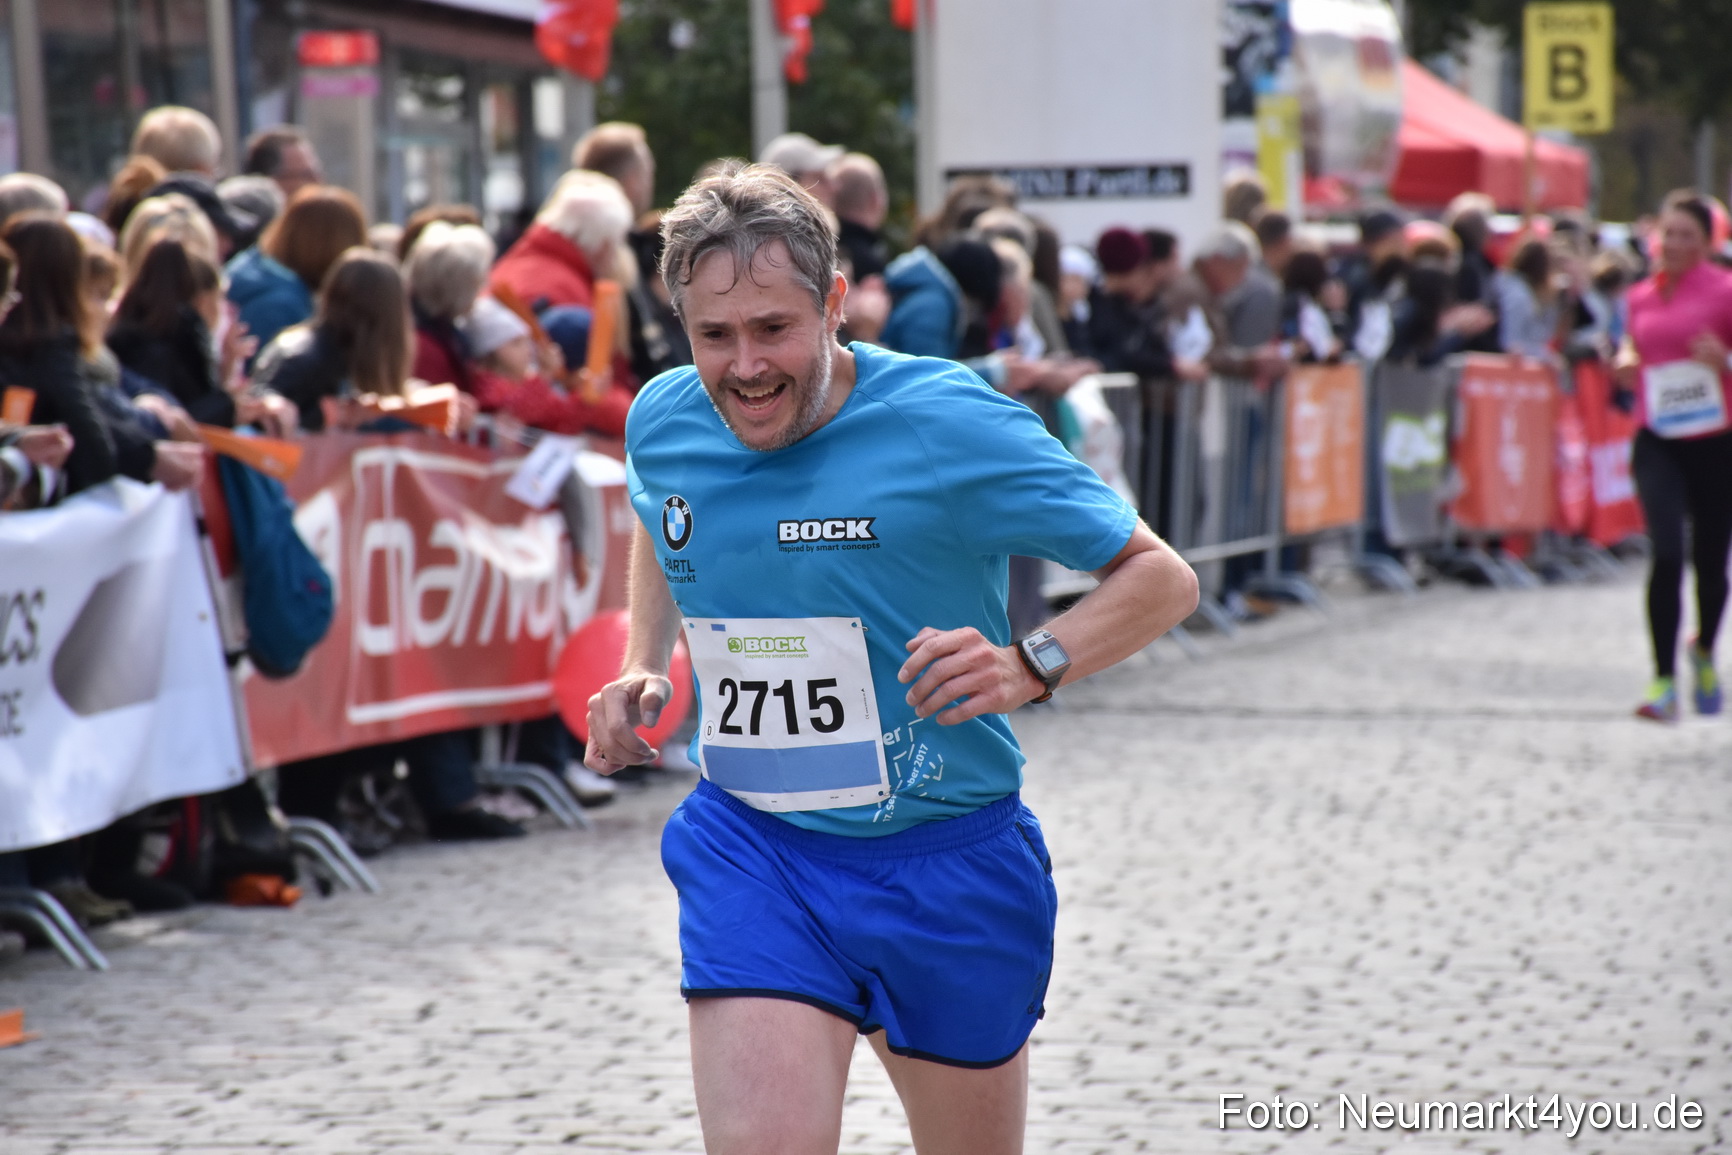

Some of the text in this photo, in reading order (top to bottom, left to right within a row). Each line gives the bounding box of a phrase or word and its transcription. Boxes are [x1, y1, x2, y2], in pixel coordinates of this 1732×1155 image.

[1547, 43, 1588, 101] B
[779, 518, 876, 543] BOCK
[778, 541, 881, 554] inspired by smart concepts
[664, 557, 696, 573] PARTL
[744, 636, 808, 653] BOCK
[718, 677, 845, 736] 2715
[914, 743, 929, 768] 2017
